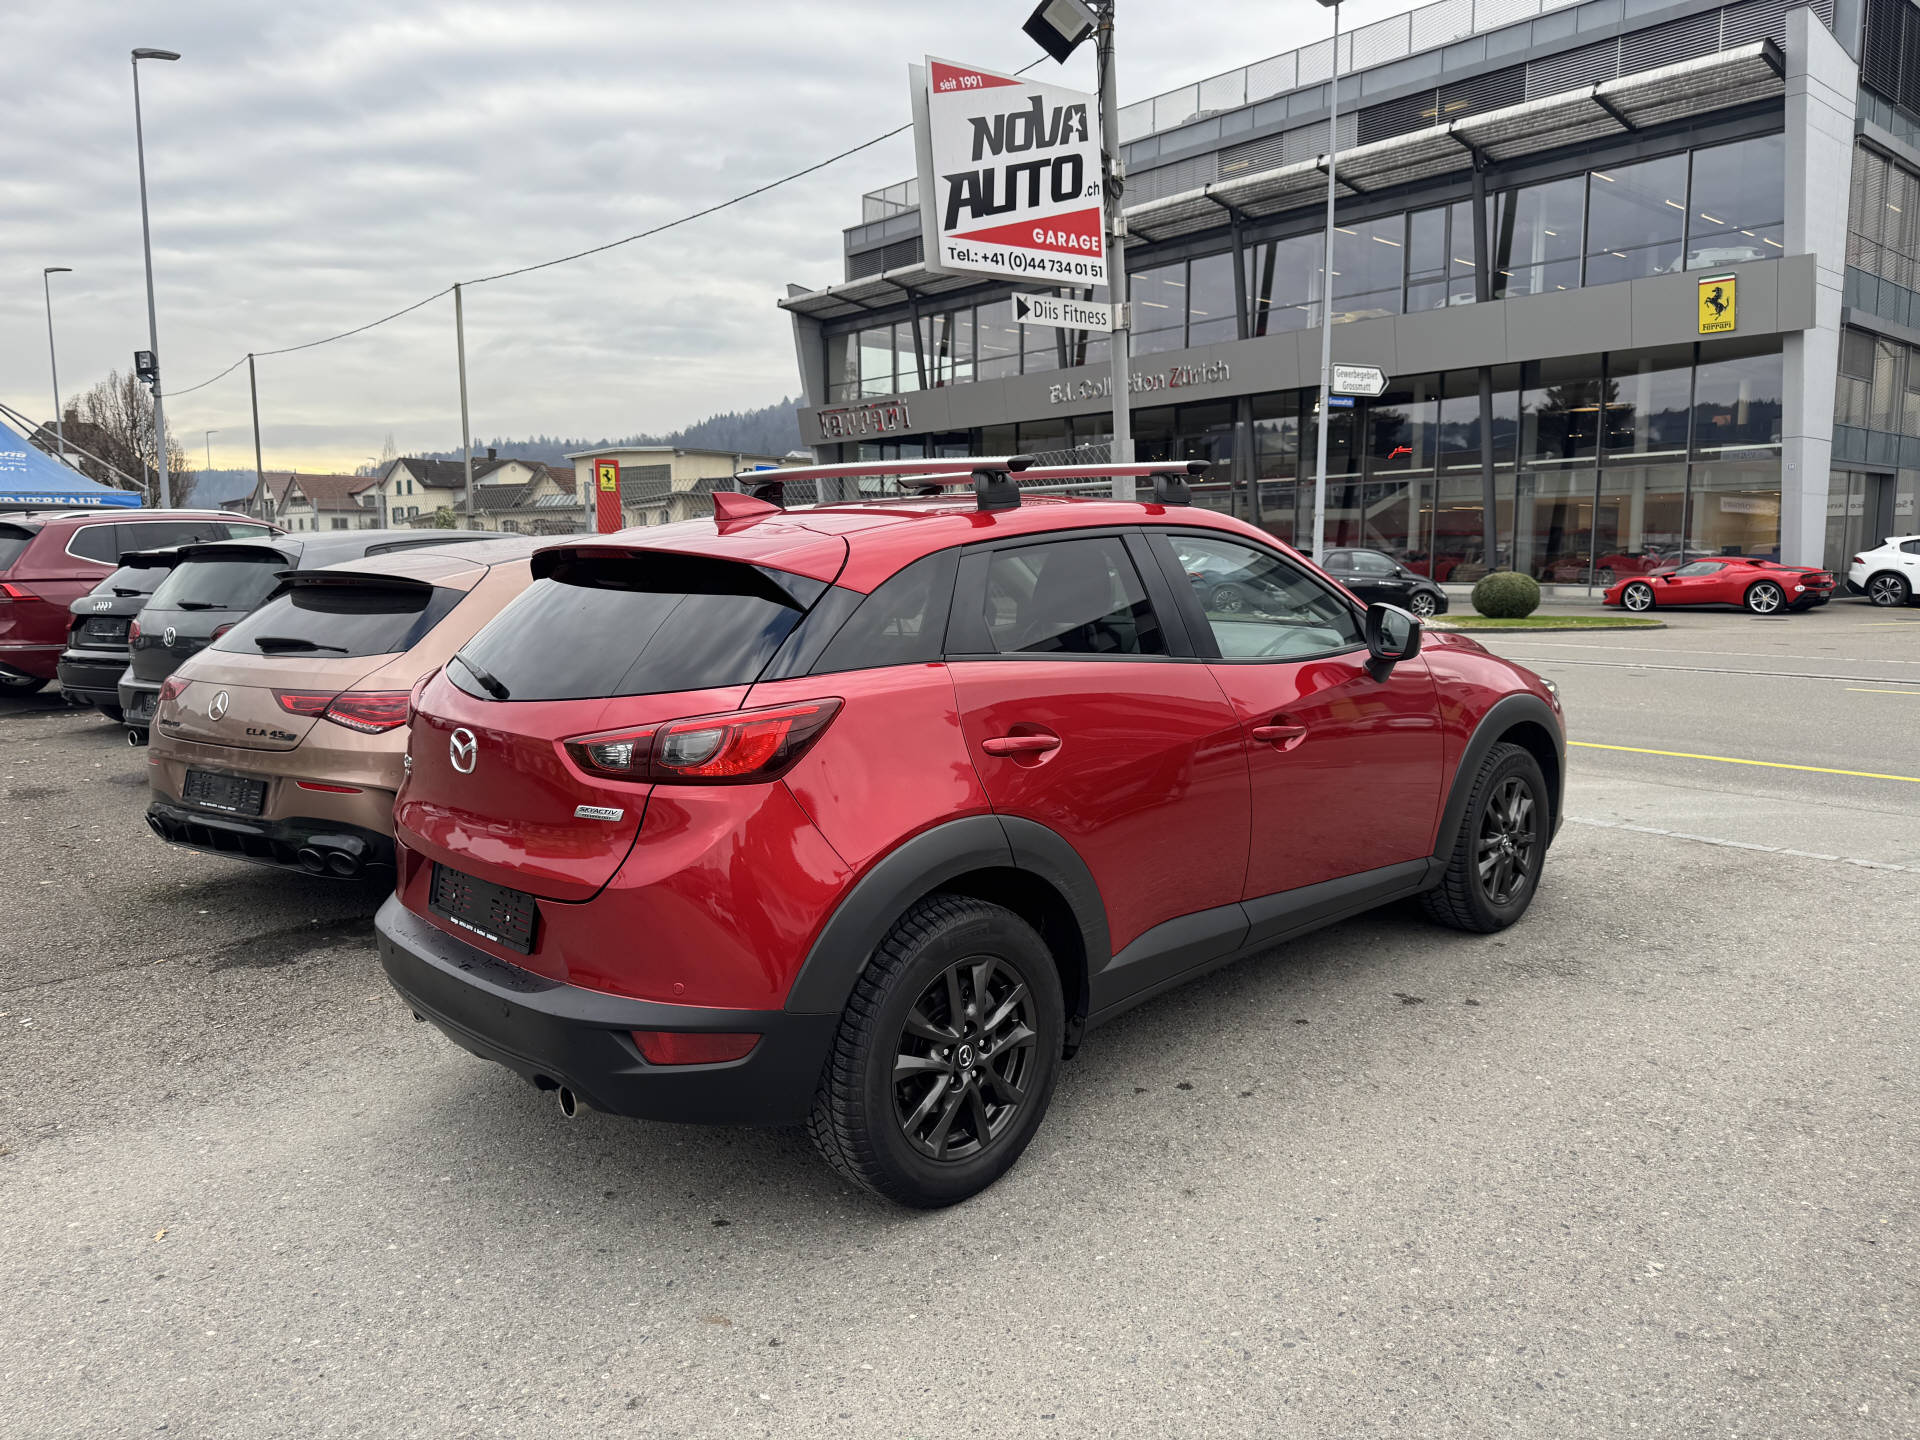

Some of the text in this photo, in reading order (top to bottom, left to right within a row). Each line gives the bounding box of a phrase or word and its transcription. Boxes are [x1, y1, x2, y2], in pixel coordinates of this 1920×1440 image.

[939, 75, 983, 91] seit 1991
[967, 94, 1089, 162] NOVA
[941, 153, 1083, 231] AUTO
[1032, 228, 1100, 251] GARAGE
[947, 247, 978, 263] Tel.:
[981, 251, 1005, 267] +41
[1008, 253, 1046, 272] (0)44
[1048, 259, 1074, 275] 734
[1034, 300, 1107, 326] Diis Fitness
[1702, 321, 1732, 331] Ferrari
[1079, 371, 1166, 401] Colltion
[1168, 359, 1230, 388] Zürich
[817, 397, 912, 439] Ferrari
[578, 806, 618, 816] SKYACTIV
